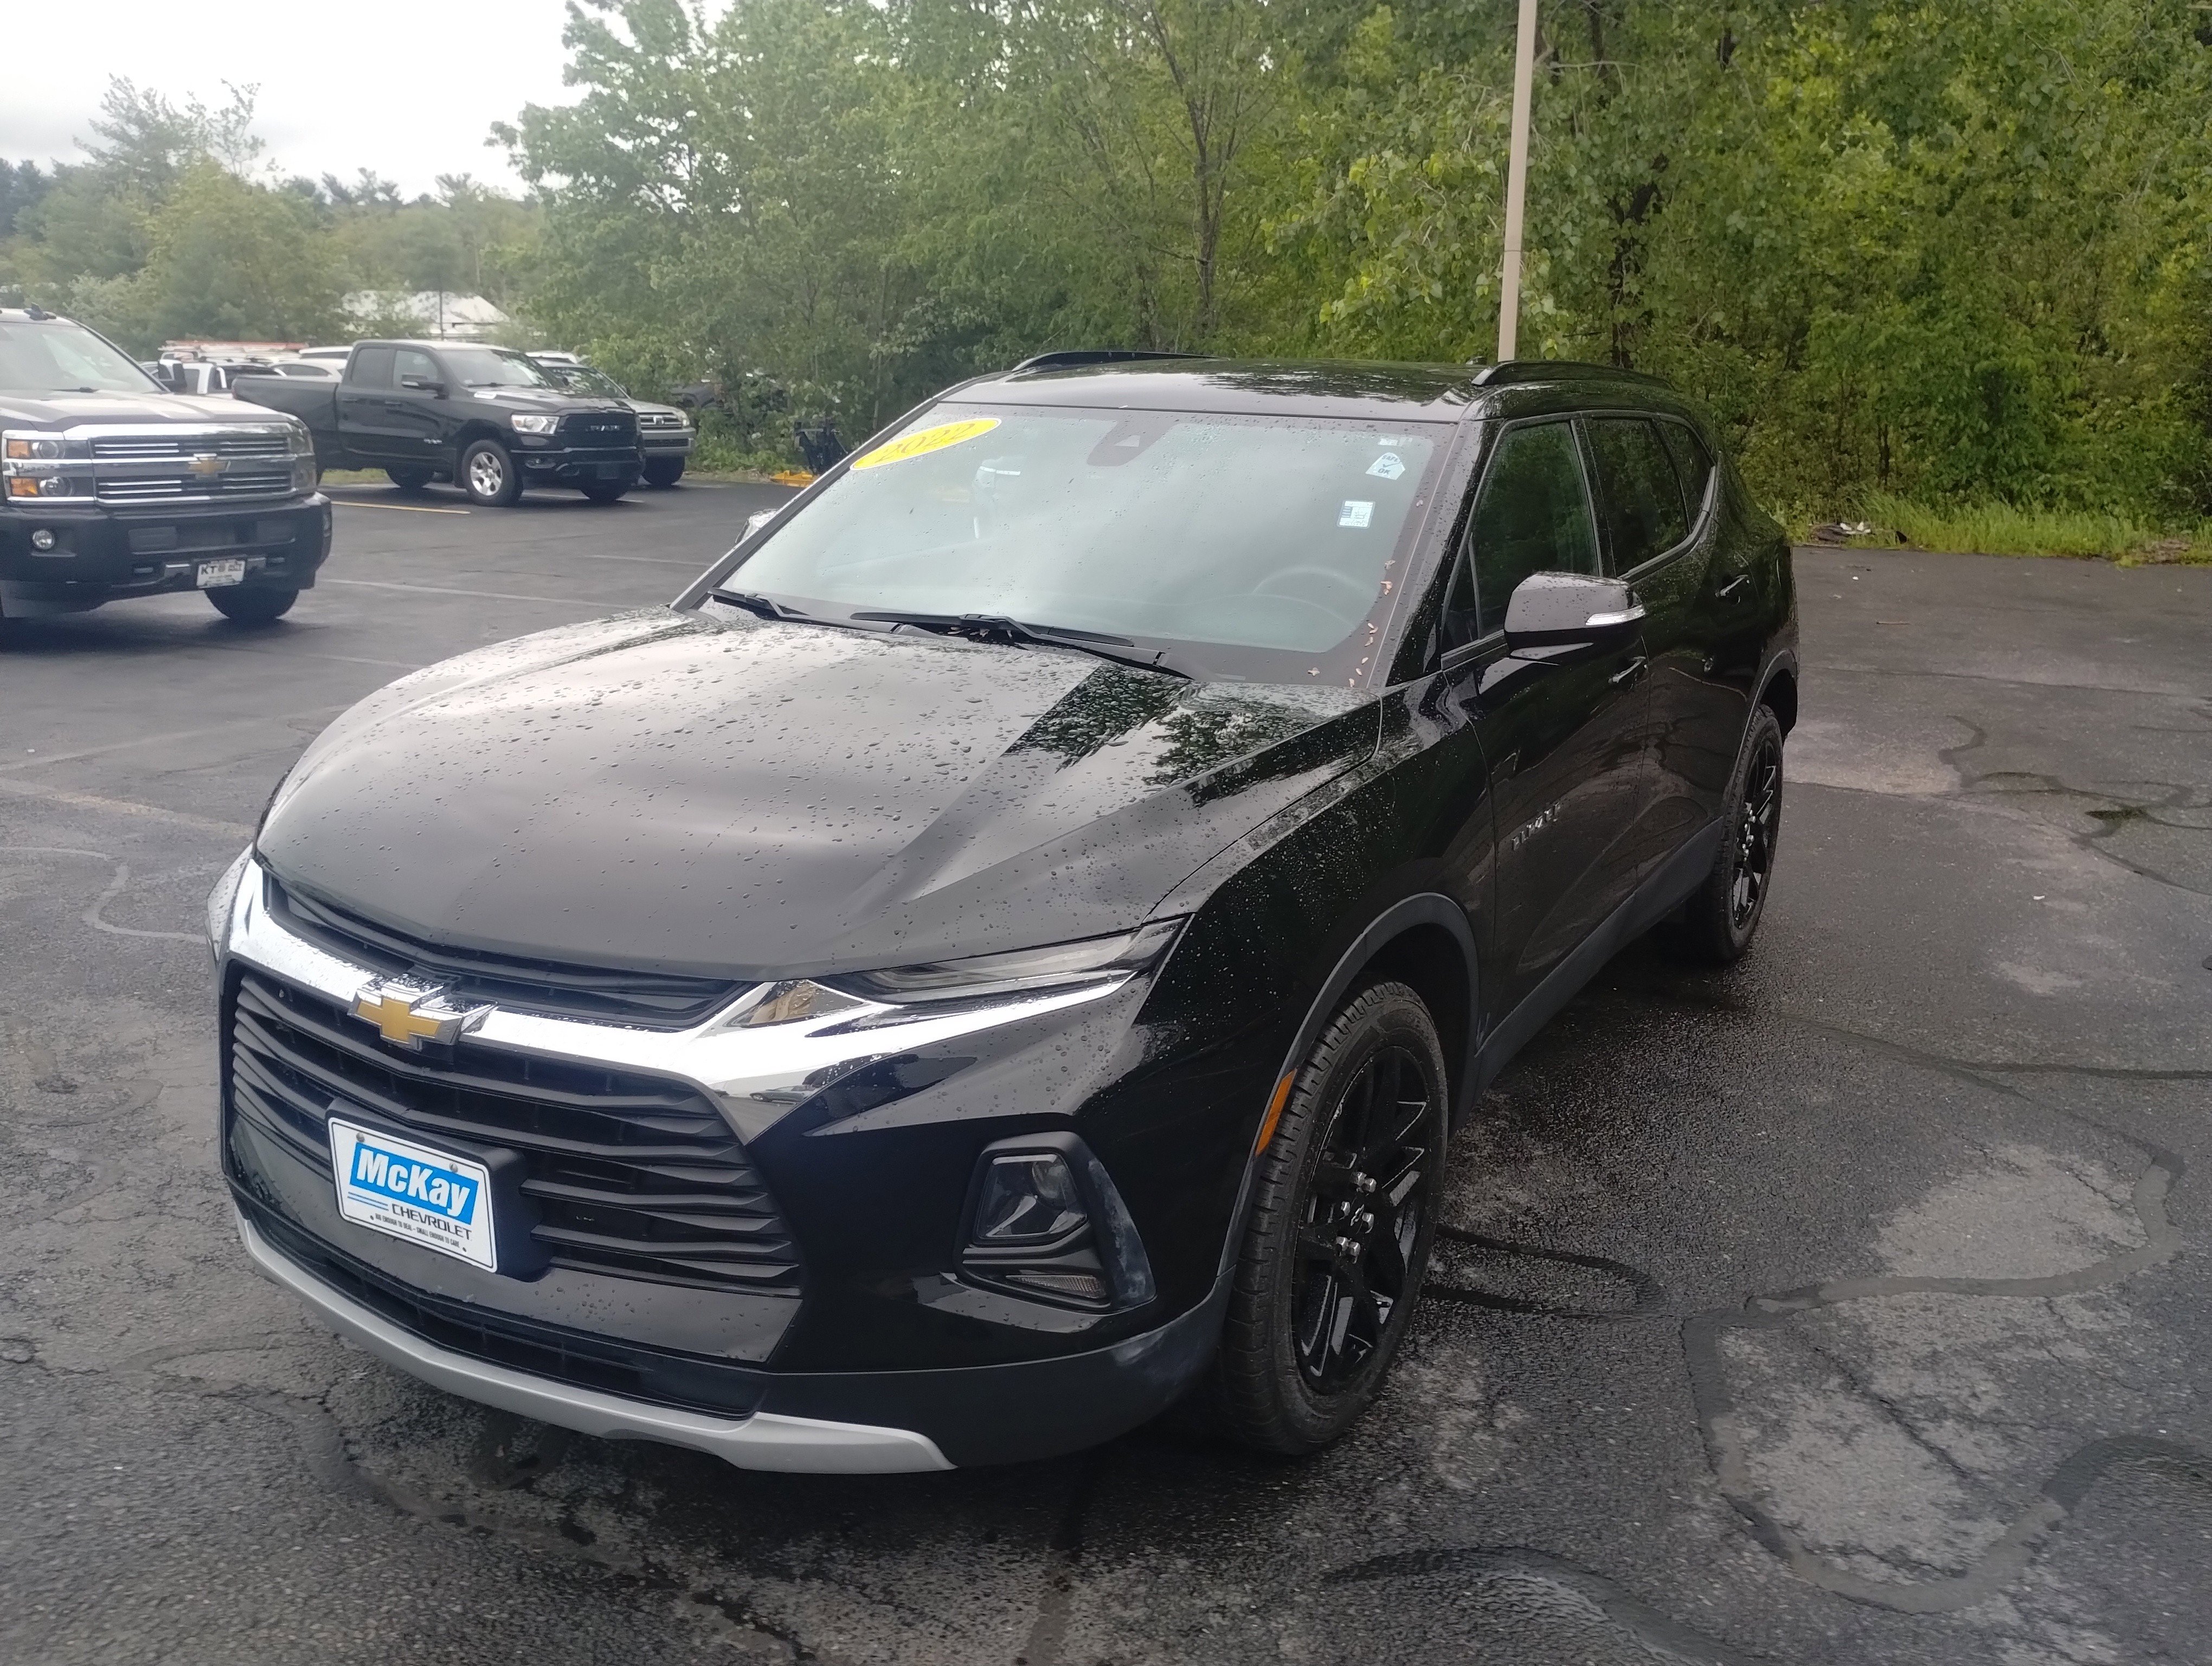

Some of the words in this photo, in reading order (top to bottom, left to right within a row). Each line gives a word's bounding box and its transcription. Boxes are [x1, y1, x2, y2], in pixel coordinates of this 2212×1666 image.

[874, 423, 976, 464] 2022
[356, 1148, 470, 1217] McKay
[391, 1203, 472, 1240] CHEVROLET
